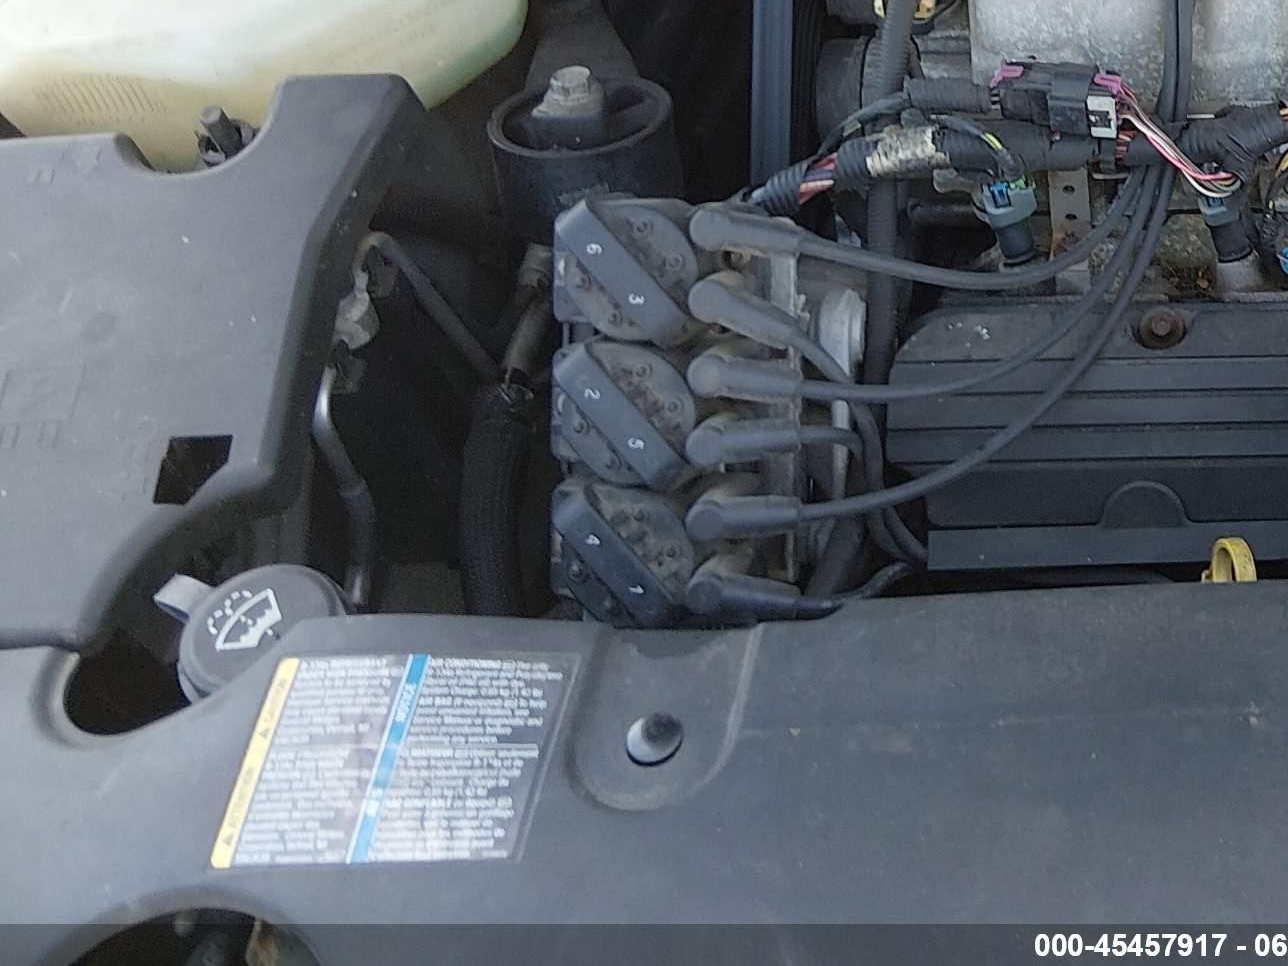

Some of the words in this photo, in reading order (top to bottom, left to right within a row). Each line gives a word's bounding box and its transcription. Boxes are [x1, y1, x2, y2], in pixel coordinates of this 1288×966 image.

[628, 293, 645, 305] 3
[584, 388, 600, 400] 2
[627, 437, 645, 450] 5
